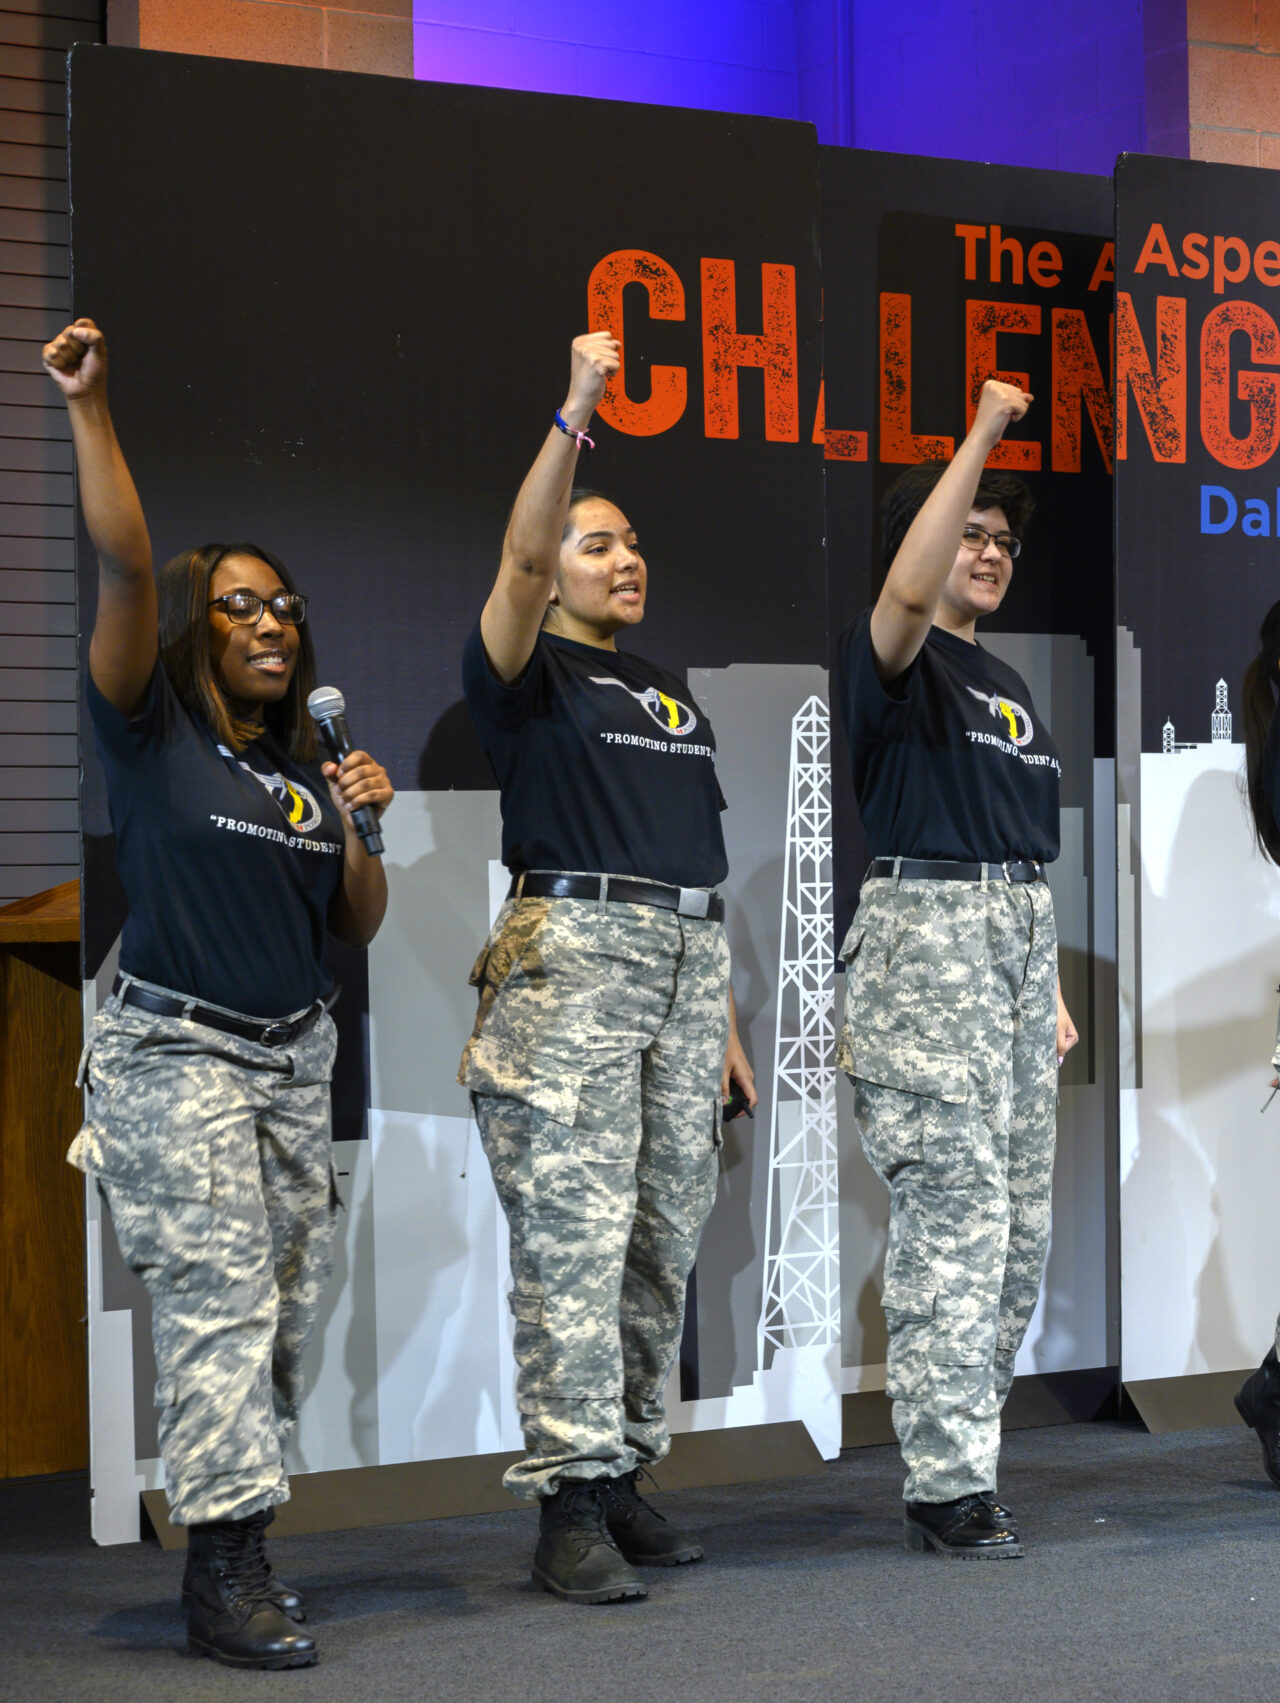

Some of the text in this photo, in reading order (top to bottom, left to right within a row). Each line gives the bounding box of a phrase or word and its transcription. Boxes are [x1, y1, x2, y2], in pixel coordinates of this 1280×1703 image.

[955, 223, 1063, 288] The
[670, 743, 711, 757] STUDENT
[210, 814, 288, 845] “PROMOTIN
[289, 837, 341, 855] STUDENT
